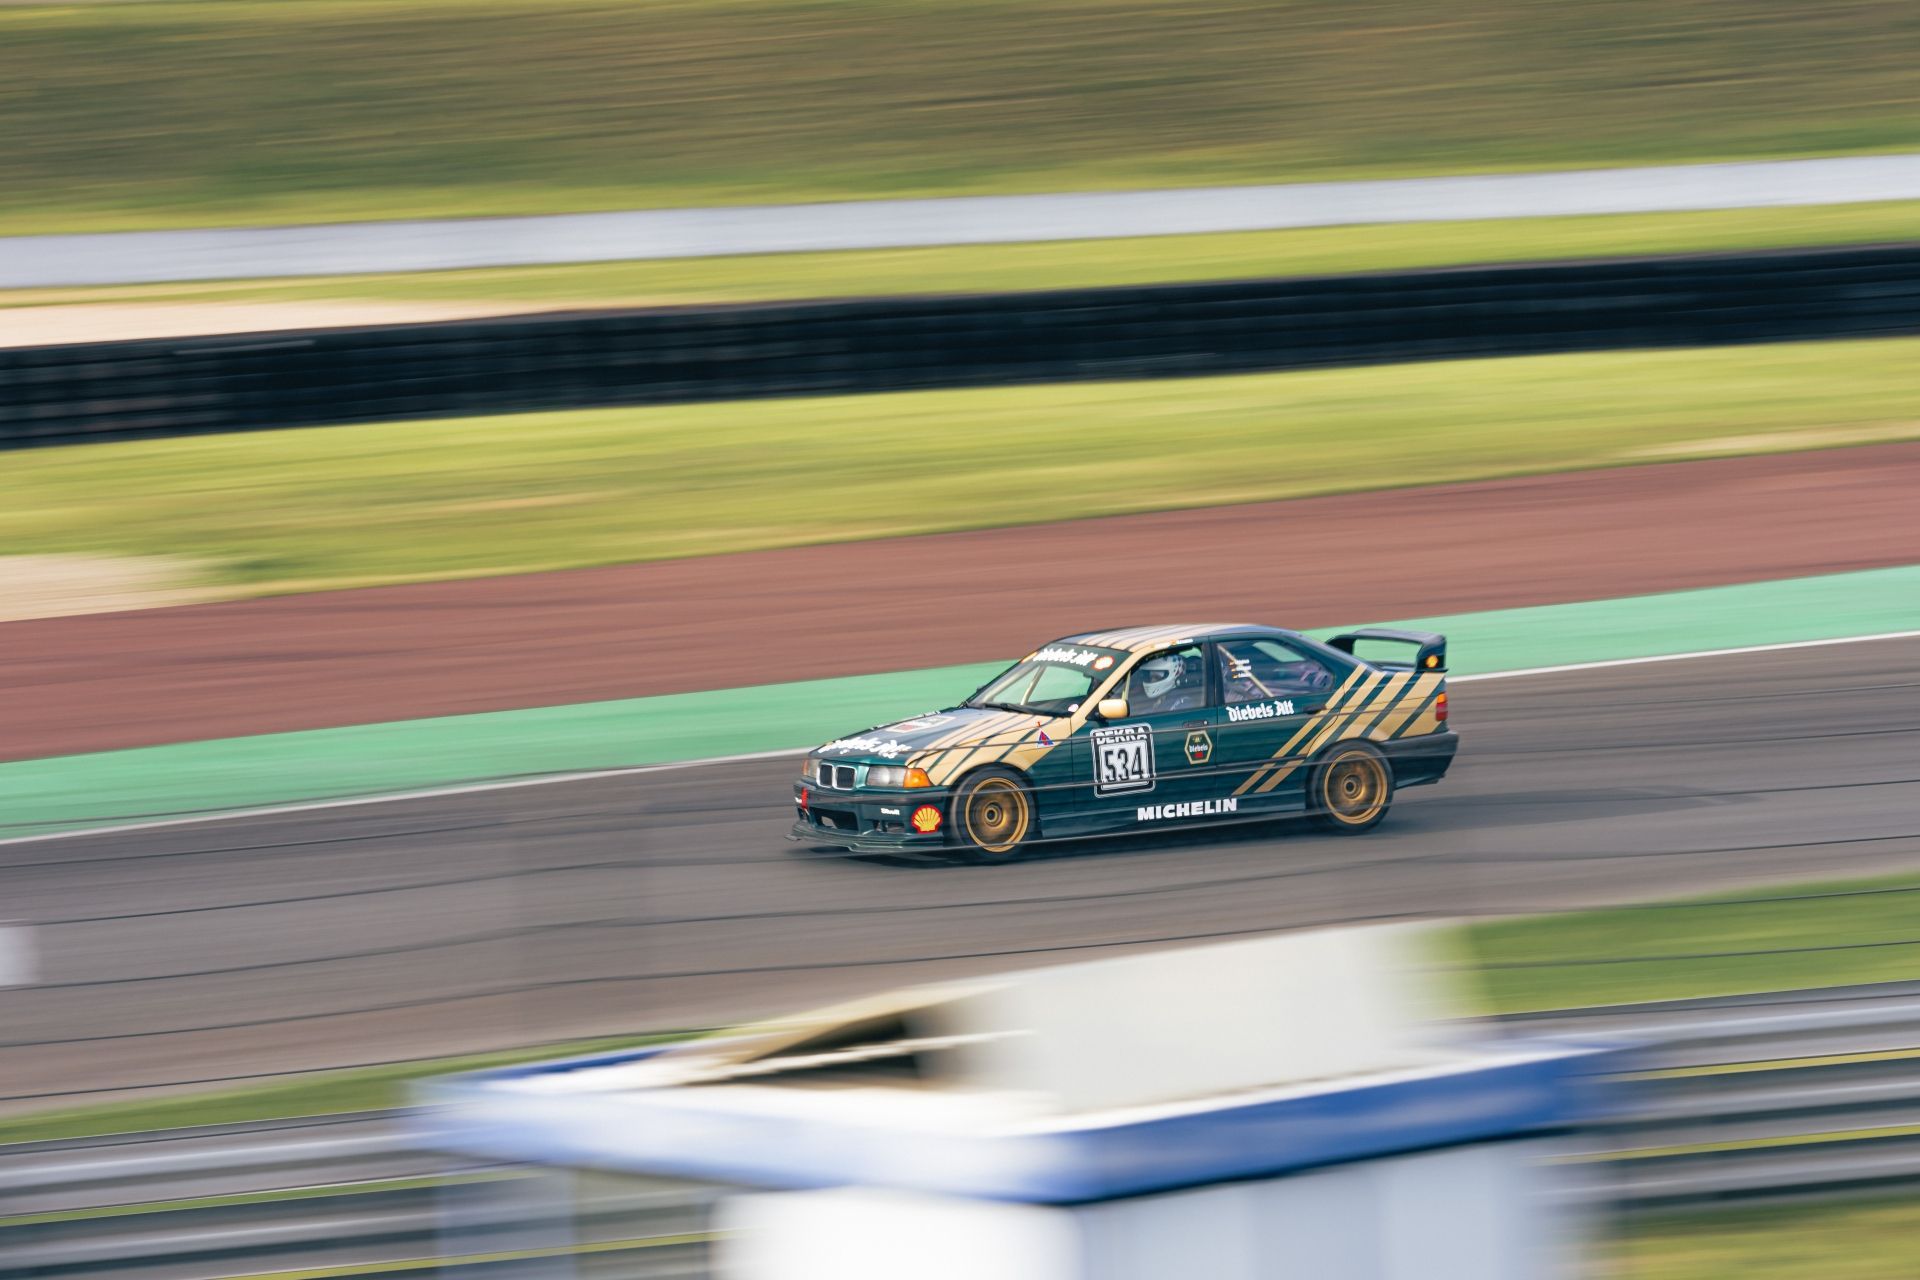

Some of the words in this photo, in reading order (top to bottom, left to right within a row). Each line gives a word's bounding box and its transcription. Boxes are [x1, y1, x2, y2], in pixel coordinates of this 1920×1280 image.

[1226, 703, 1273, 722] Diebels
[1274, 700, 1295, 716] Alt
[1095, 727, 1147, 745] DEKRA
[1104, 747, 1143, 782] 534
[1137, 798, 1237, 821] MICHELIN
